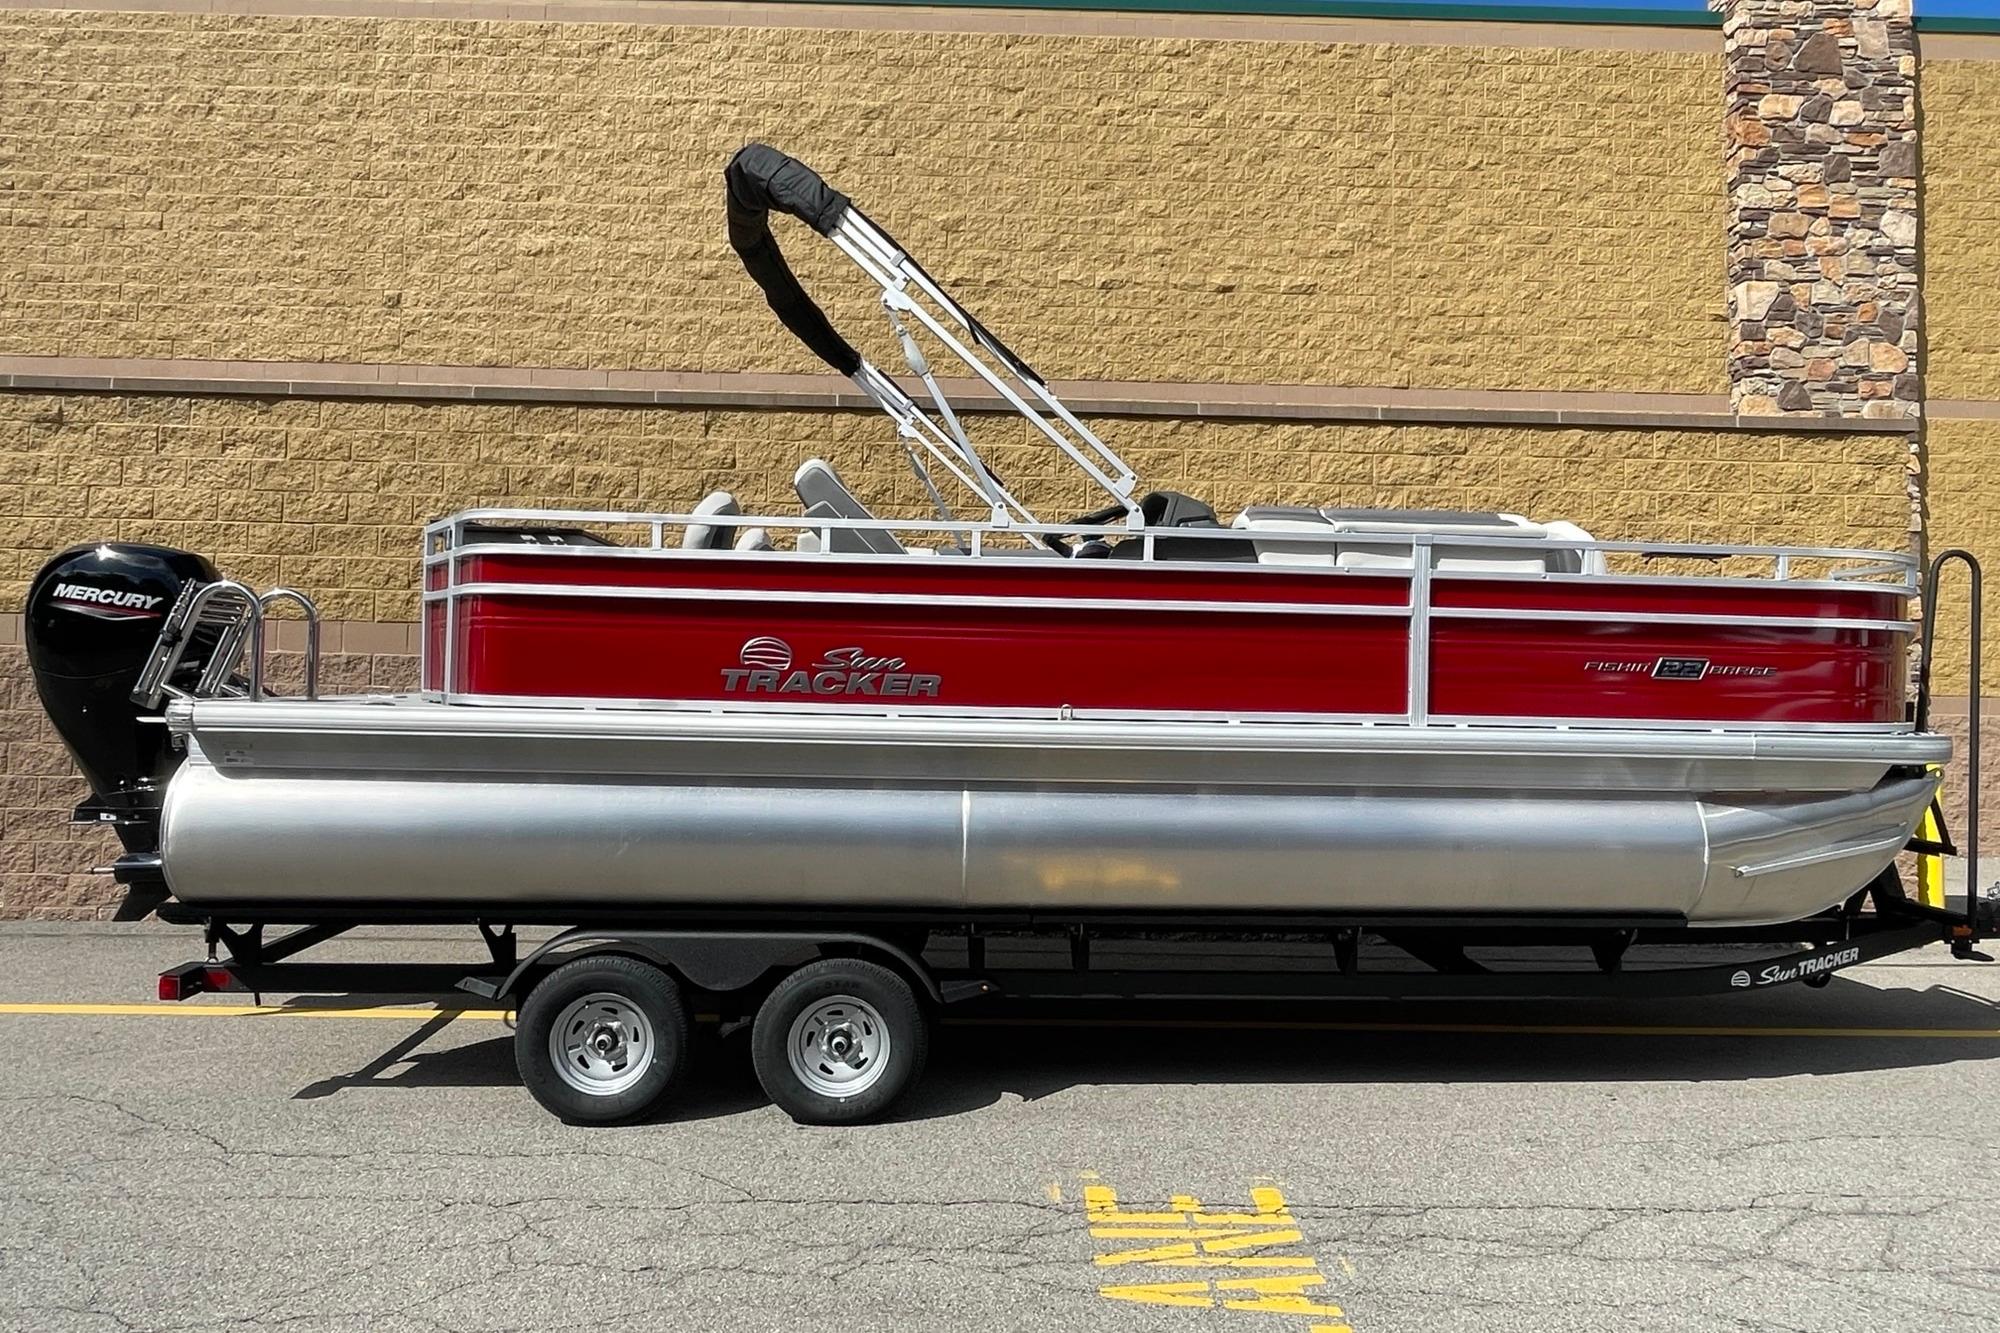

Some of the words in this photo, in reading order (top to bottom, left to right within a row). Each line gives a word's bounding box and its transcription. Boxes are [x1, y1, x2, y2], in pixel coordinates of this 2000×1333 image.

[52, 583, 163, 609] MERCURY
[812, 647, 906, 670] Sun
[1661, 661, 1701, 677] 22
[1708, 665, 1778, 676] BARGE
[720, 668, 942, 697] TRACKER
[1755, 965, 1798, 985] Sun
[1798, 947, 1859, 976] TRACKER
[1084, 1185, 1354, 1333] ANE
